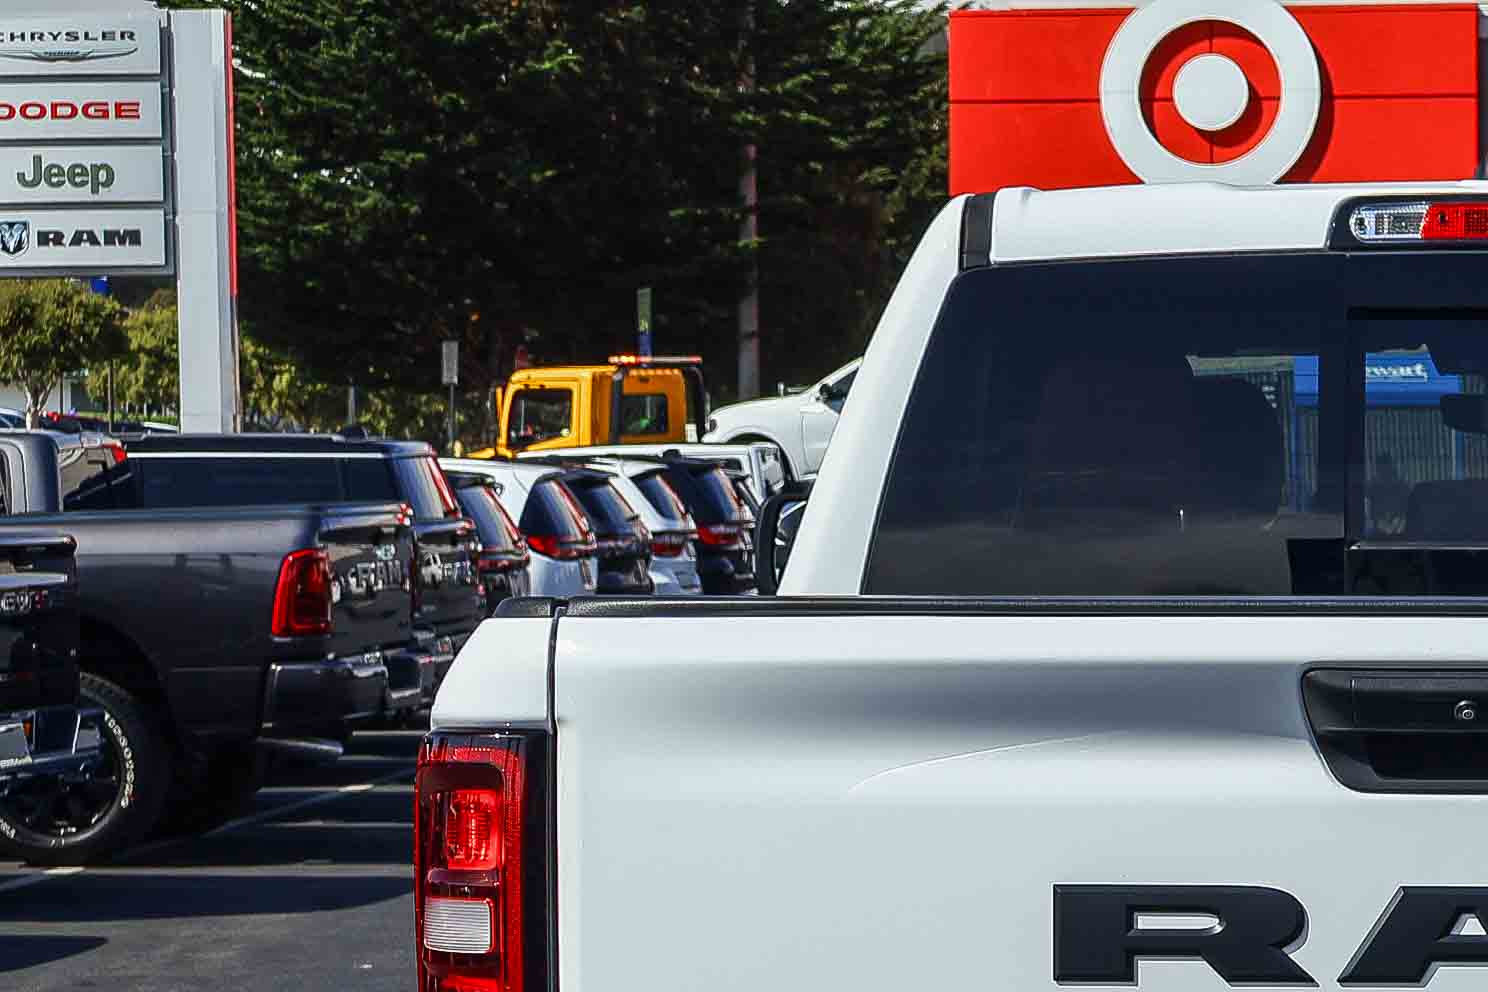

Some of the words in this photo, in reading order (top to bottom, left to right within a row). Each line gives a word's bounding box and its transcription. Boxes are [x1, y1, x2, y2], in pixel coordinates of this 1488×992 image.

[0, 31, 136, 42] HRYSLER
[0, 101, 141, 121] DODGE
[16, 154, 116, 195] Jeep
[37, 229, 142, 247] RAM
